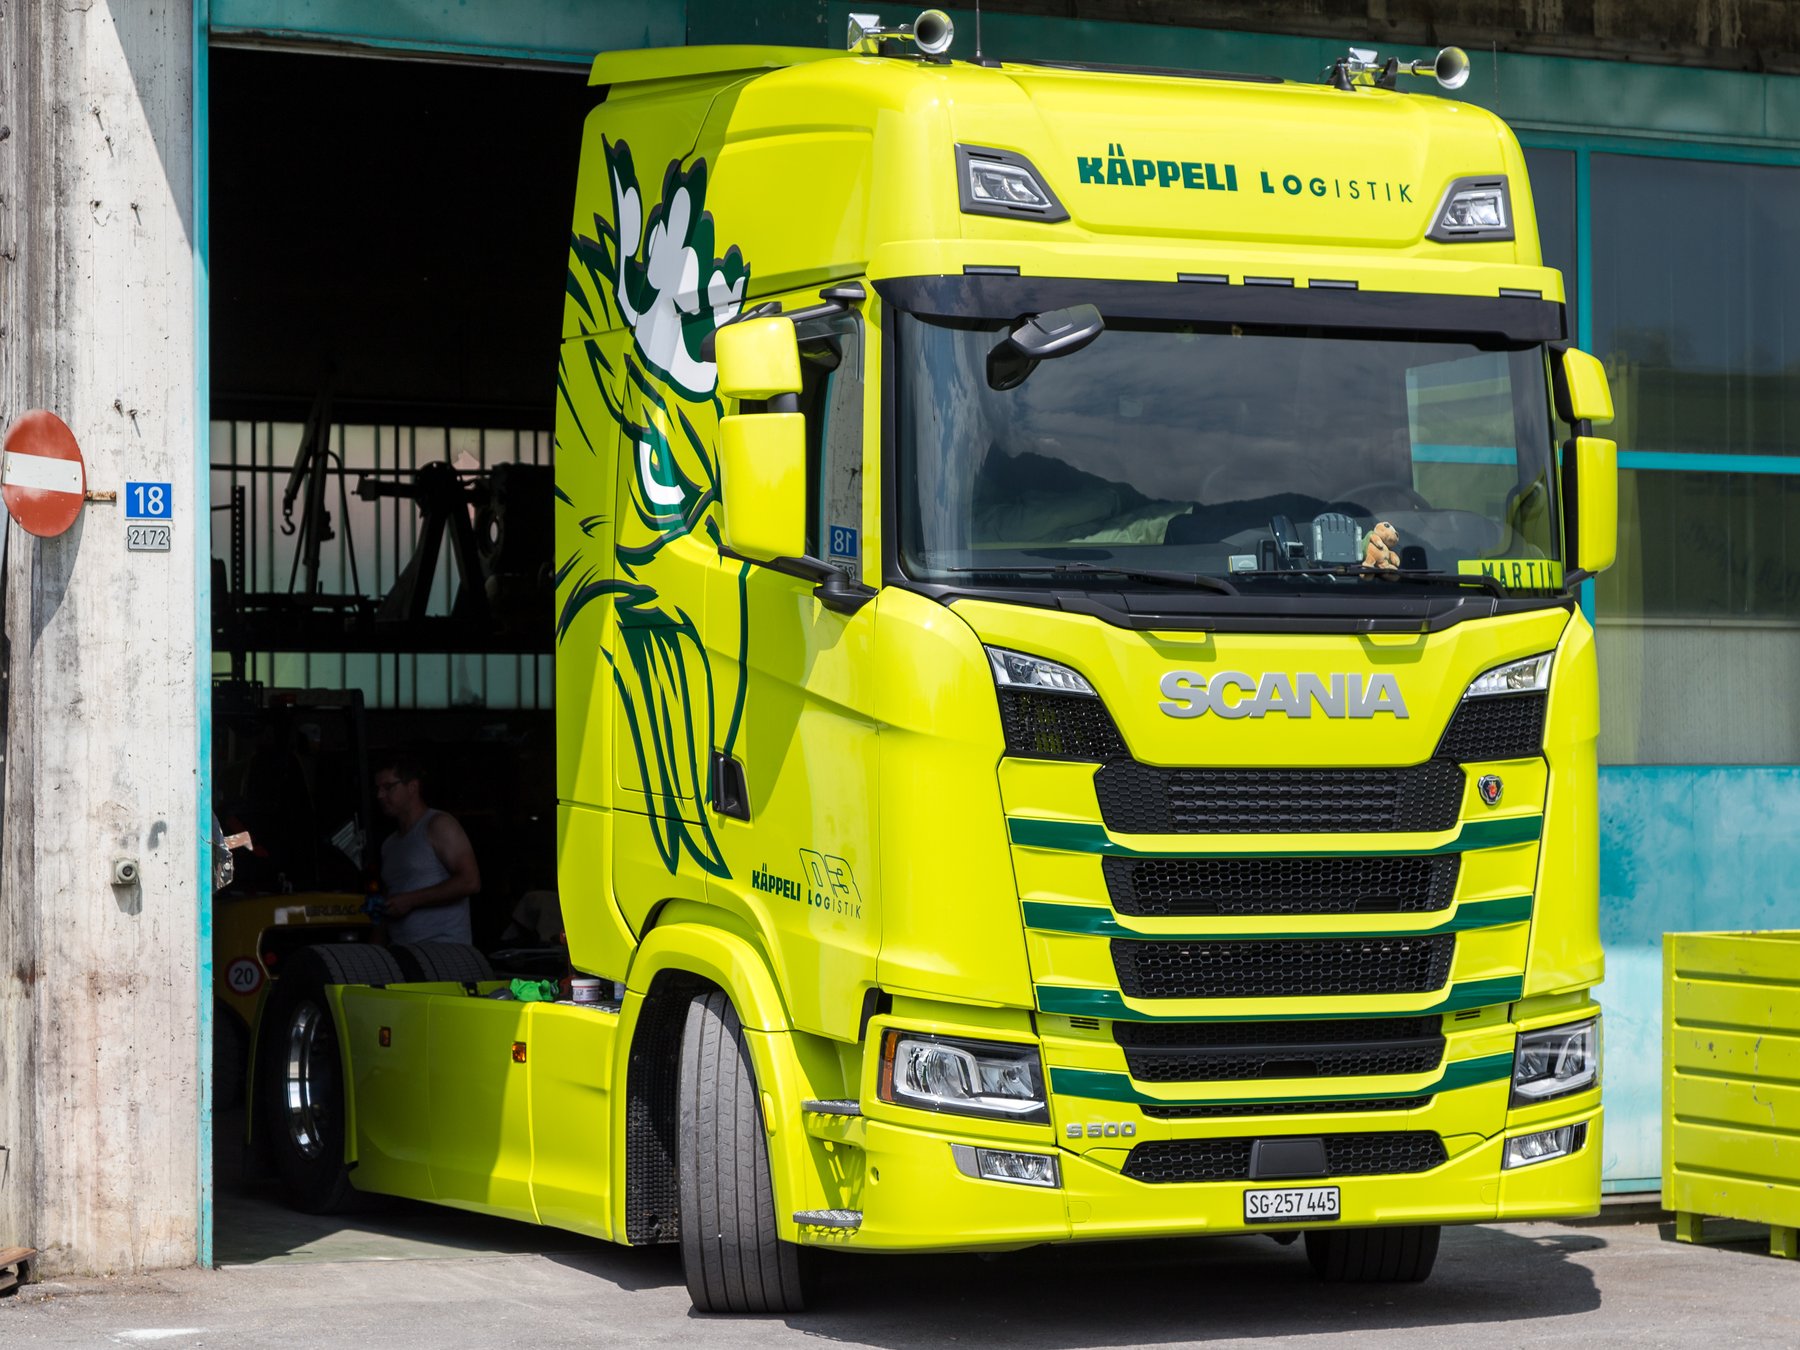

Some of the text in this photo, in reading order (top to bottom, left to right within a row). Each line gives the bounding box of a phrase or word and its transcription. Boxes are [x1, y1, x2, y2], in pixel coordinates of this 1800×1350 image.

[1077, 143, 1413, 202] KÄPPELI LOGISTIK
[134, 486, 164, 515] 18
[132, 529, 166, 545] 2172
[1158, 670, 1410, 719] SCANIA
[752, 862, 861, 919] KÄPPELI LOGISTIK
[234, 967, 254, 985] 20
[1066, 1121, 1136, 1138] S 500
